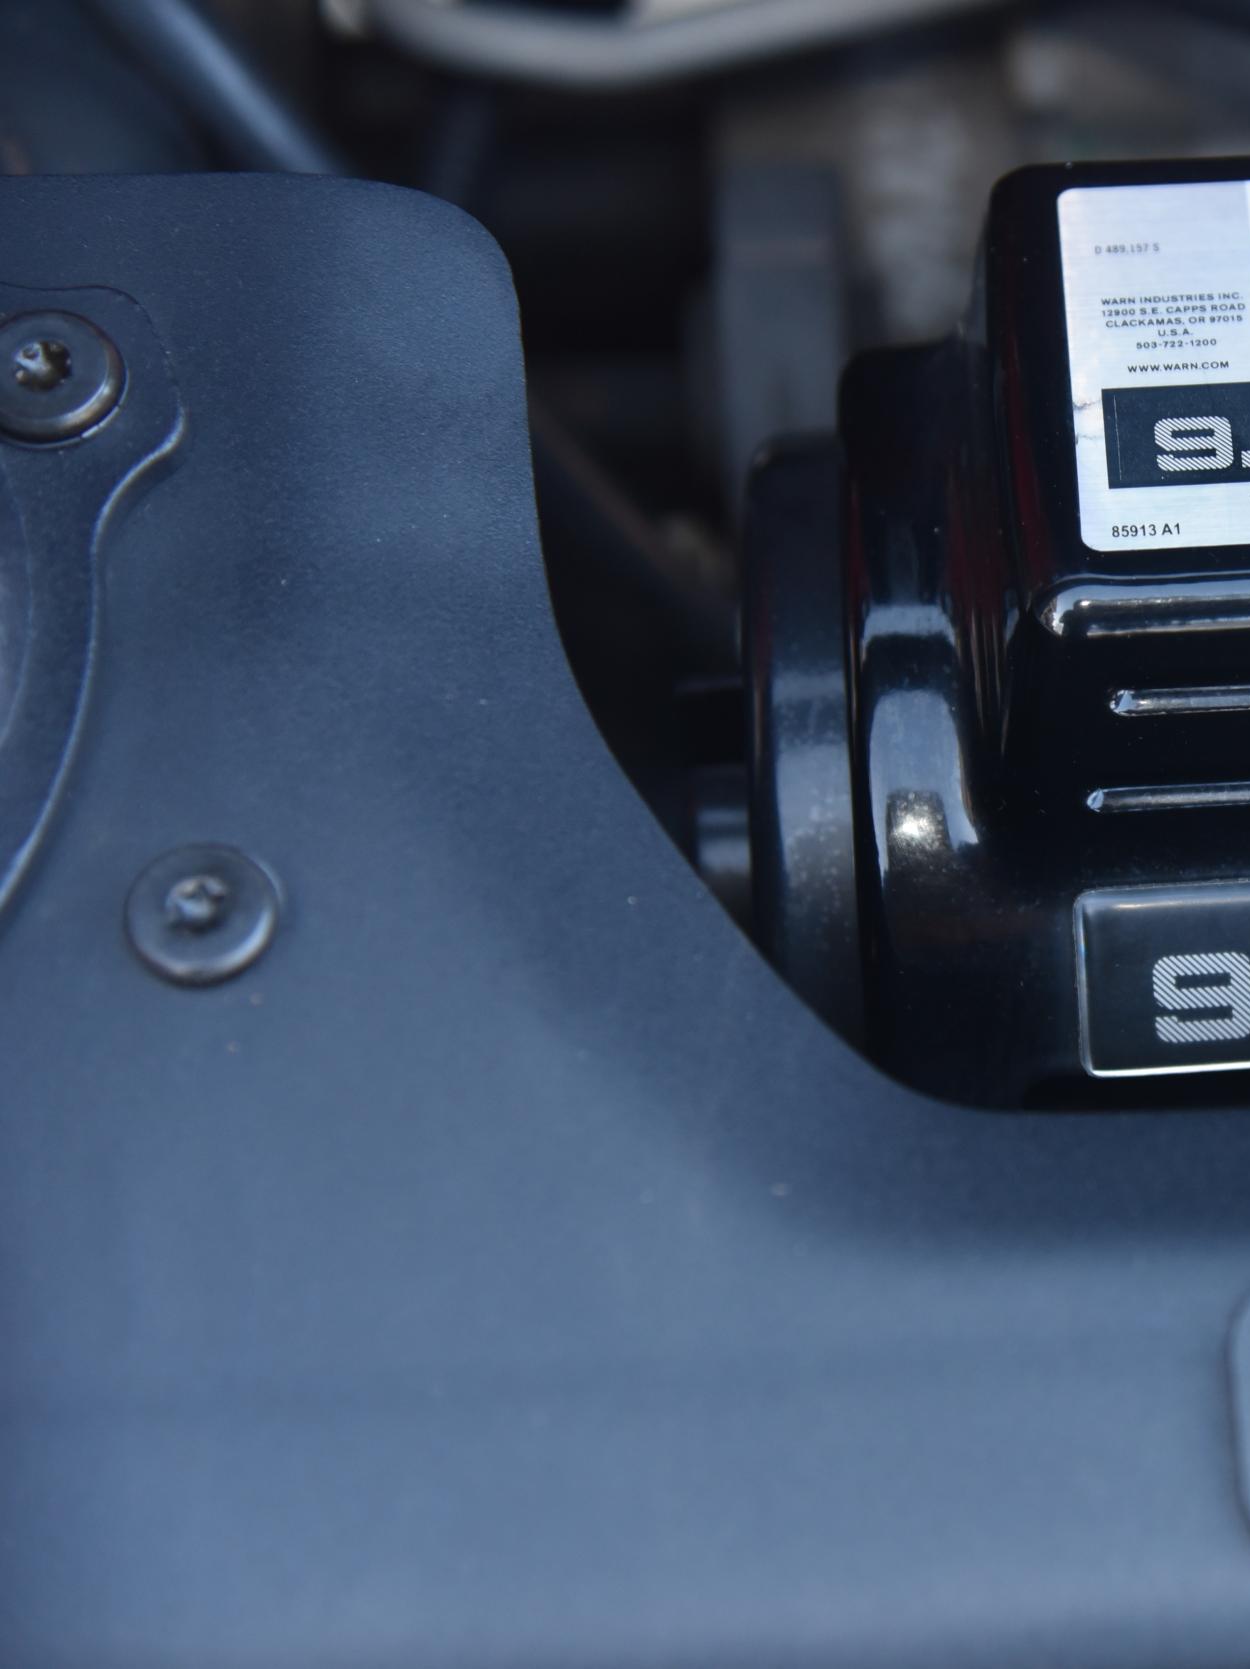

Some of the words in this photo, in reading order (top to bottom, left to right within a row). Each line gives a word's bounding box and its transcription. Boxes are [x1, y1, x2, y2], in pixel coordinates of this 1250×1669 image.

[1101, 296, 1136, 306] WARN
[1139, 293, 1215, 304] INDUSTRIES
[1218, 291, 1244, 301] INC.
[1139, 306, 1163, 316] S.E.
[1166, 304, 1207, 314] CAPPS
[1210, 302, 1246, 312] ROAD
[1105, 317, 1185, 328] CLACKAMAS,
[1188, 315, 1206, 324] OR
[1209, 314, 1243, 323] 97015
[1157, 328, 1194, 337] U.S.A.
[1136, 338, 1217, 350] 503-722-1200
[1127, 360, 1230, 373] WWW.WARN.COM
[1111, 523, 1158, 539] 85913
[1161, 522, 1182, 536] A1
